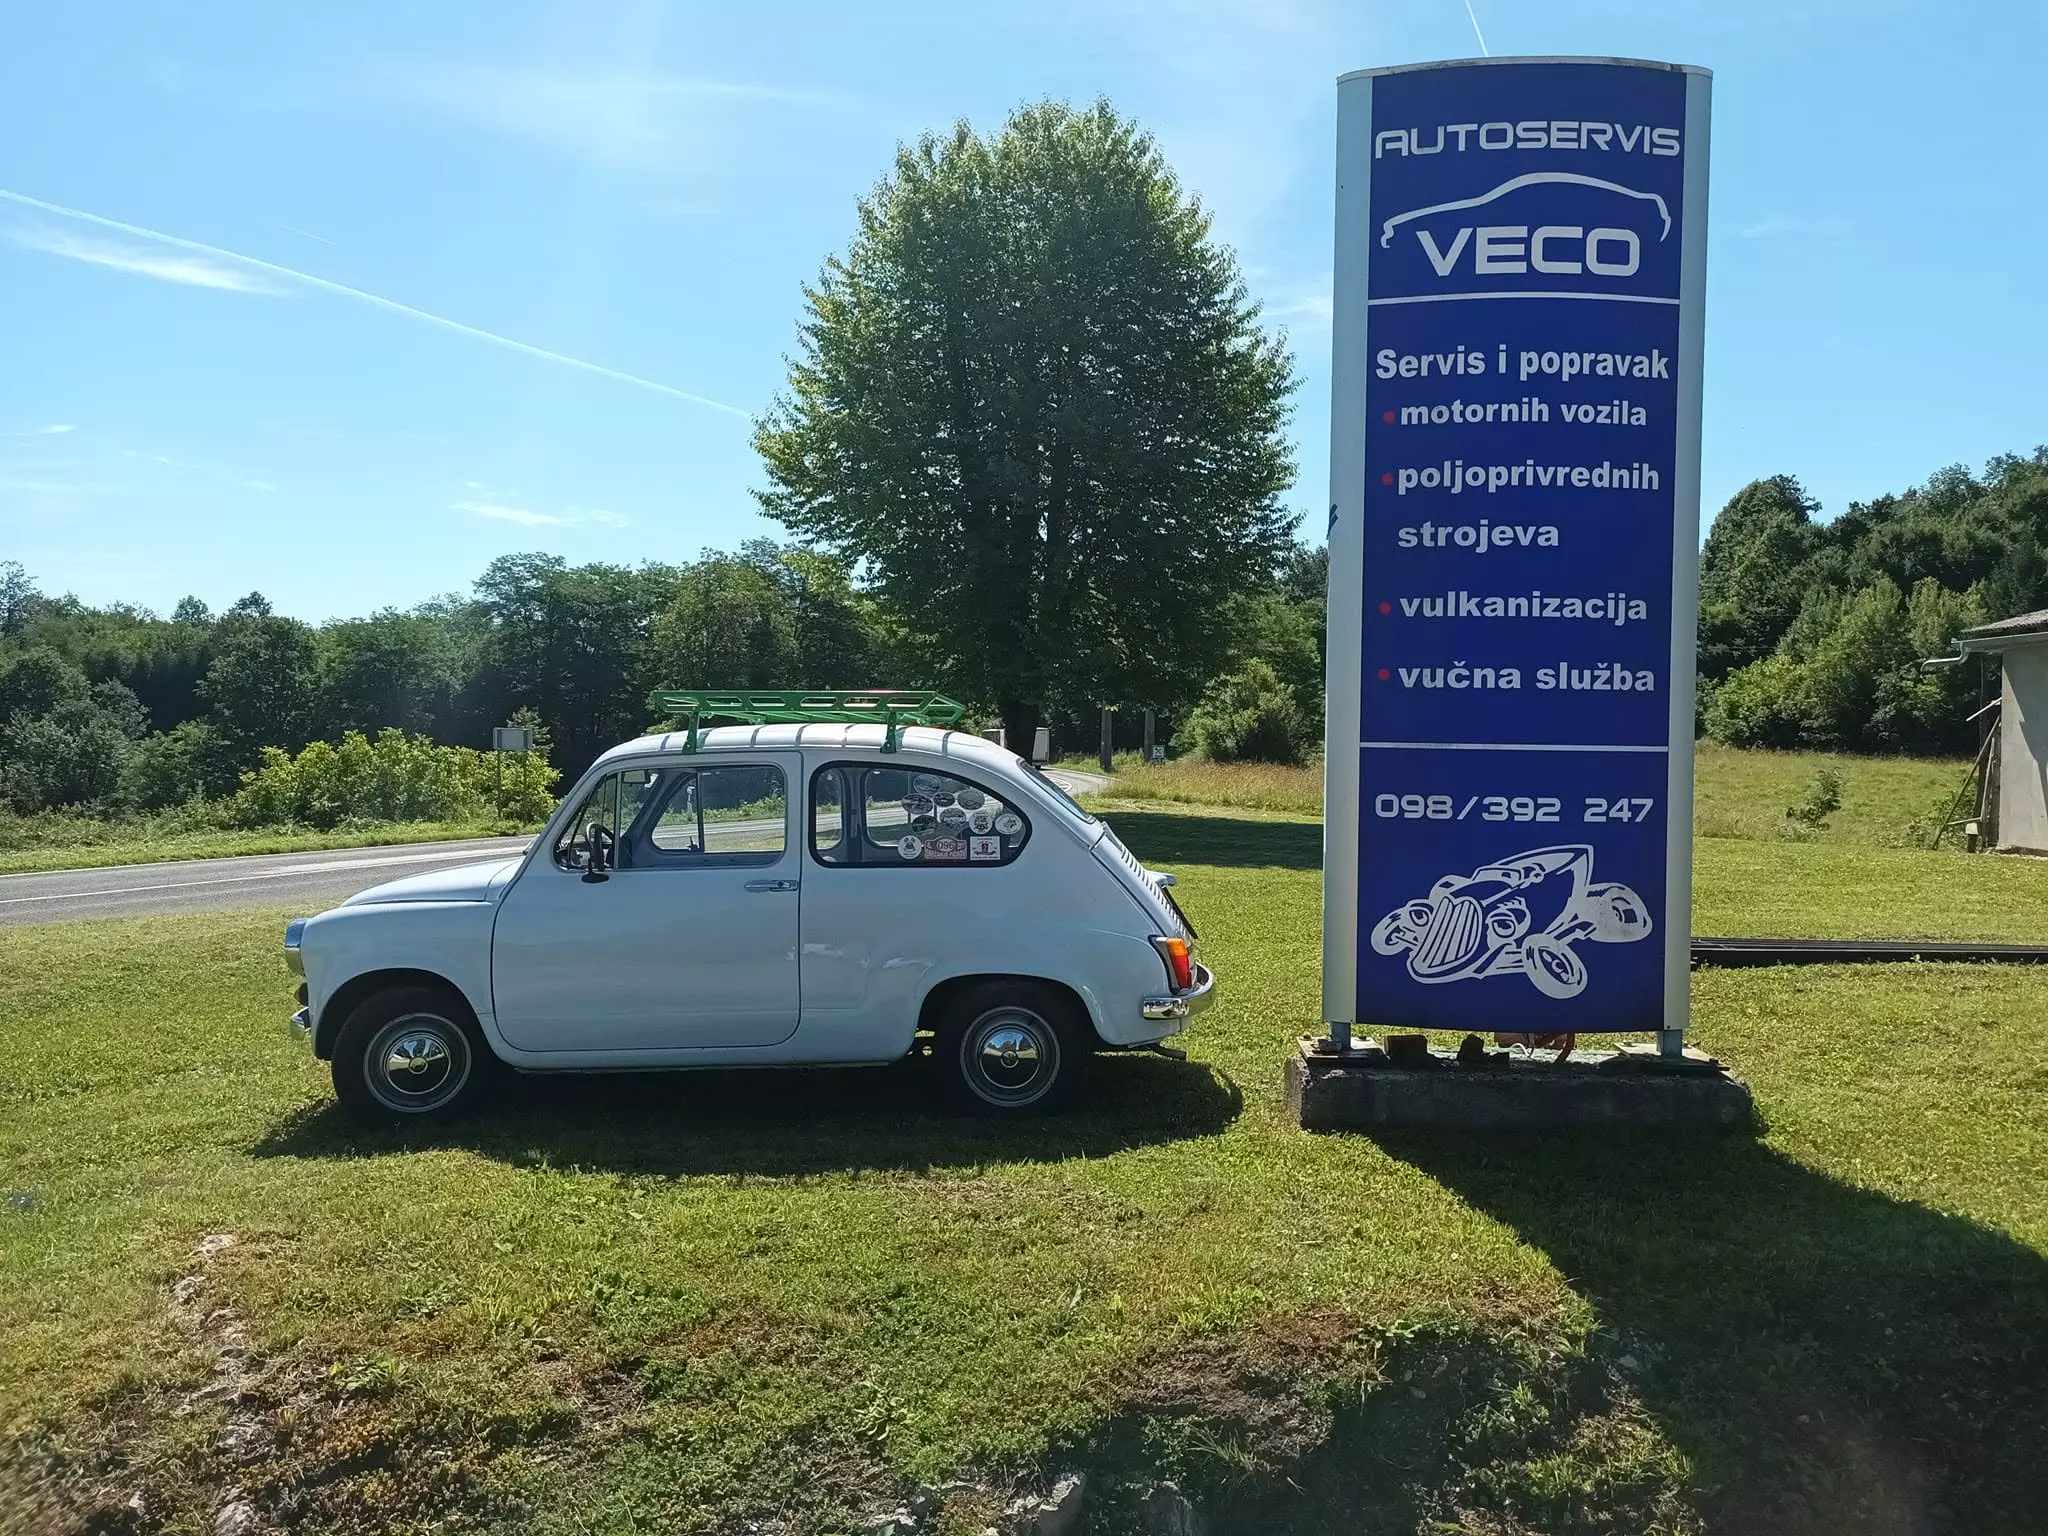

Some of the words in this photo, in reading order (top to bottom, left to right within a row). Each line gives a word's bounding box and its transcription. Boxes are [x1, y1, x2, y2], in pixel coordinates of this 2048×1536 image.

[1375, 120, 1680, 159] AUTOSERVIS
[1415, 225, 1641, 277] VECO
[1375, 345, 1486, 379] Servis
[1498, 344, 1507, 374] i
[1519, 349, 1669, 382] popravak
[1401, 397, 1549, 425] motornih
[1560, 399, 1647, 426] vozila
[1398, 459, 1659, 496] poljoprivrednih
[1397, 519, 1559, 554] strojeva
[1399, 590, 1647, 626] vulkanizacija
[1397, 660, 1521, 689] vučna
[1535, 661, 1654, 691] služba
[1375, 793, 1561, 822] 098/392
[1583, 797, 1654, 823] 247
